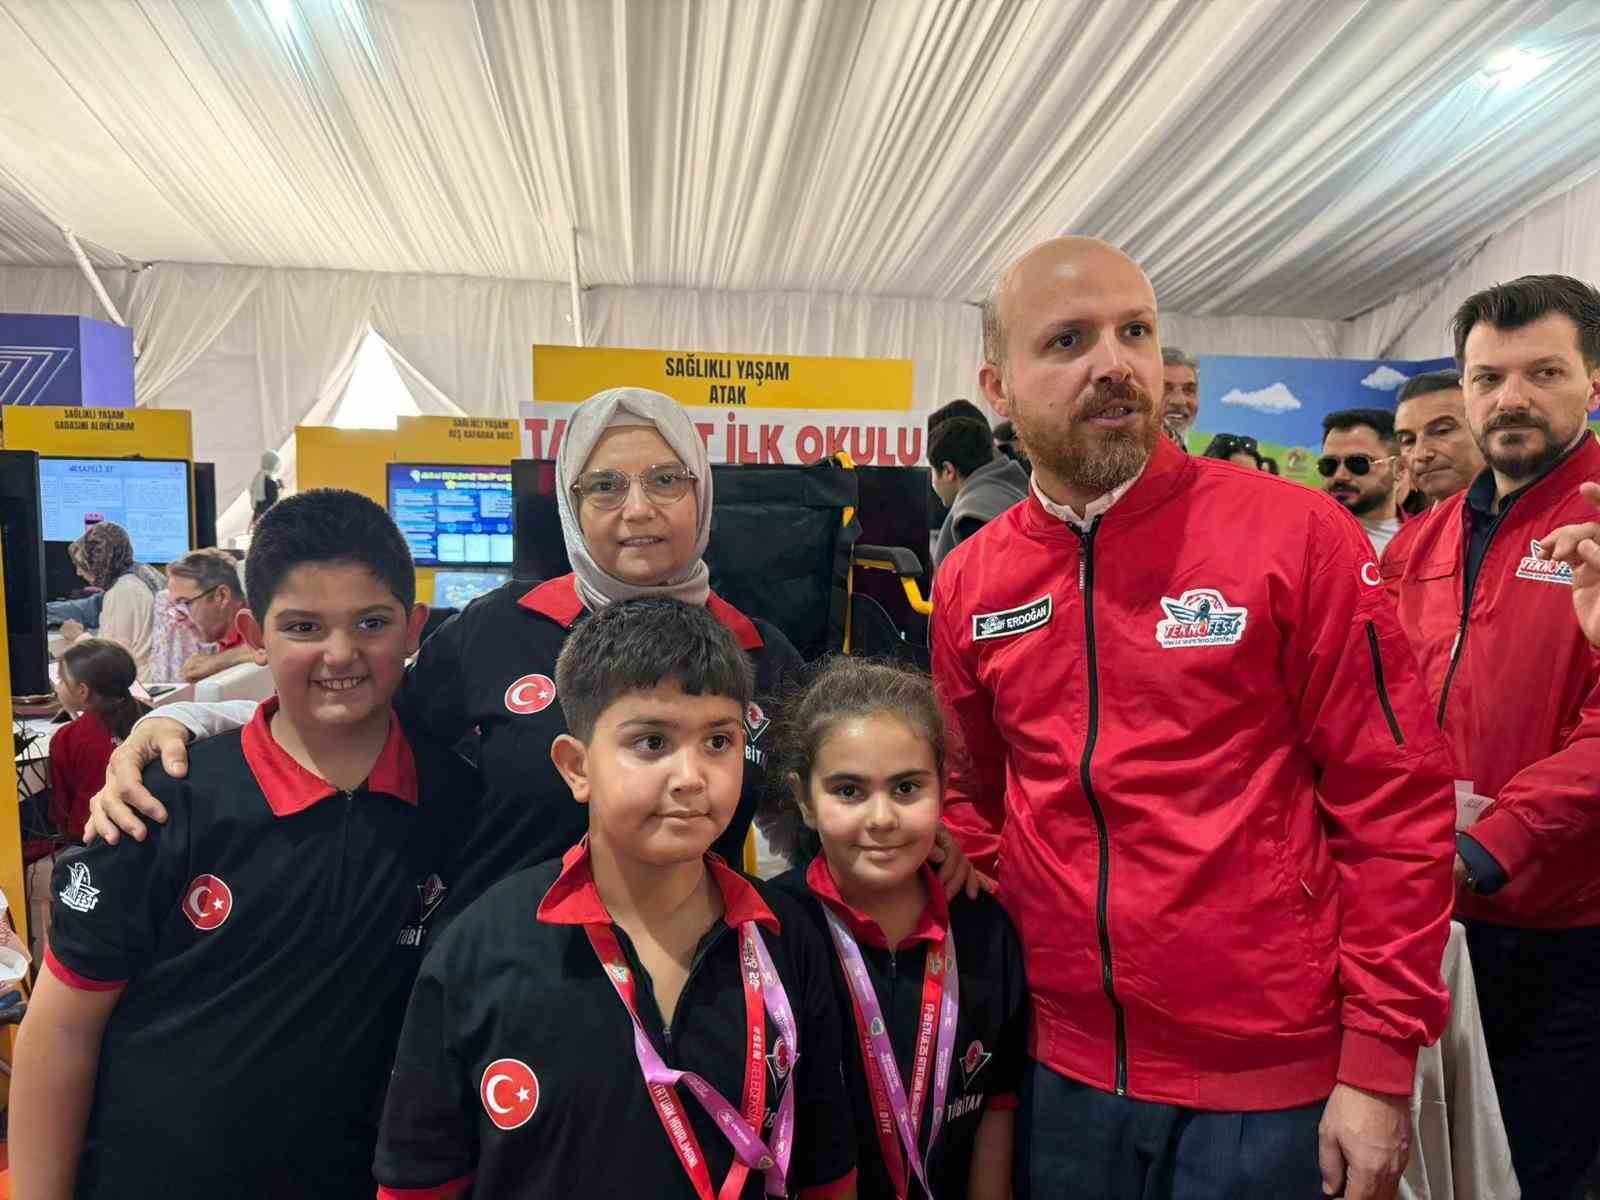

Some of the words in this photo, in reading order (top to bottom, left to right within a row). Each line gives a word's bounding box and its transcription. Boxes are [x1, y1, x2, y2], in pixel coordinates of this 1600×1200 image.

[666, 353, 731, 379] SAĞLIKLI
[737, 360, 790, 386] YAŞAM
[709, 384, 747, 405] ATAK
[726, 412, 785, 466] İLK
[795, 425, 922, 467] OKULU
[1520, 558, 1574, 577] TEKNOFE
[1006, 605, 1047, 630] ERDOĞAN
[1164, 621, 1242, 640] TEKNOFEST
